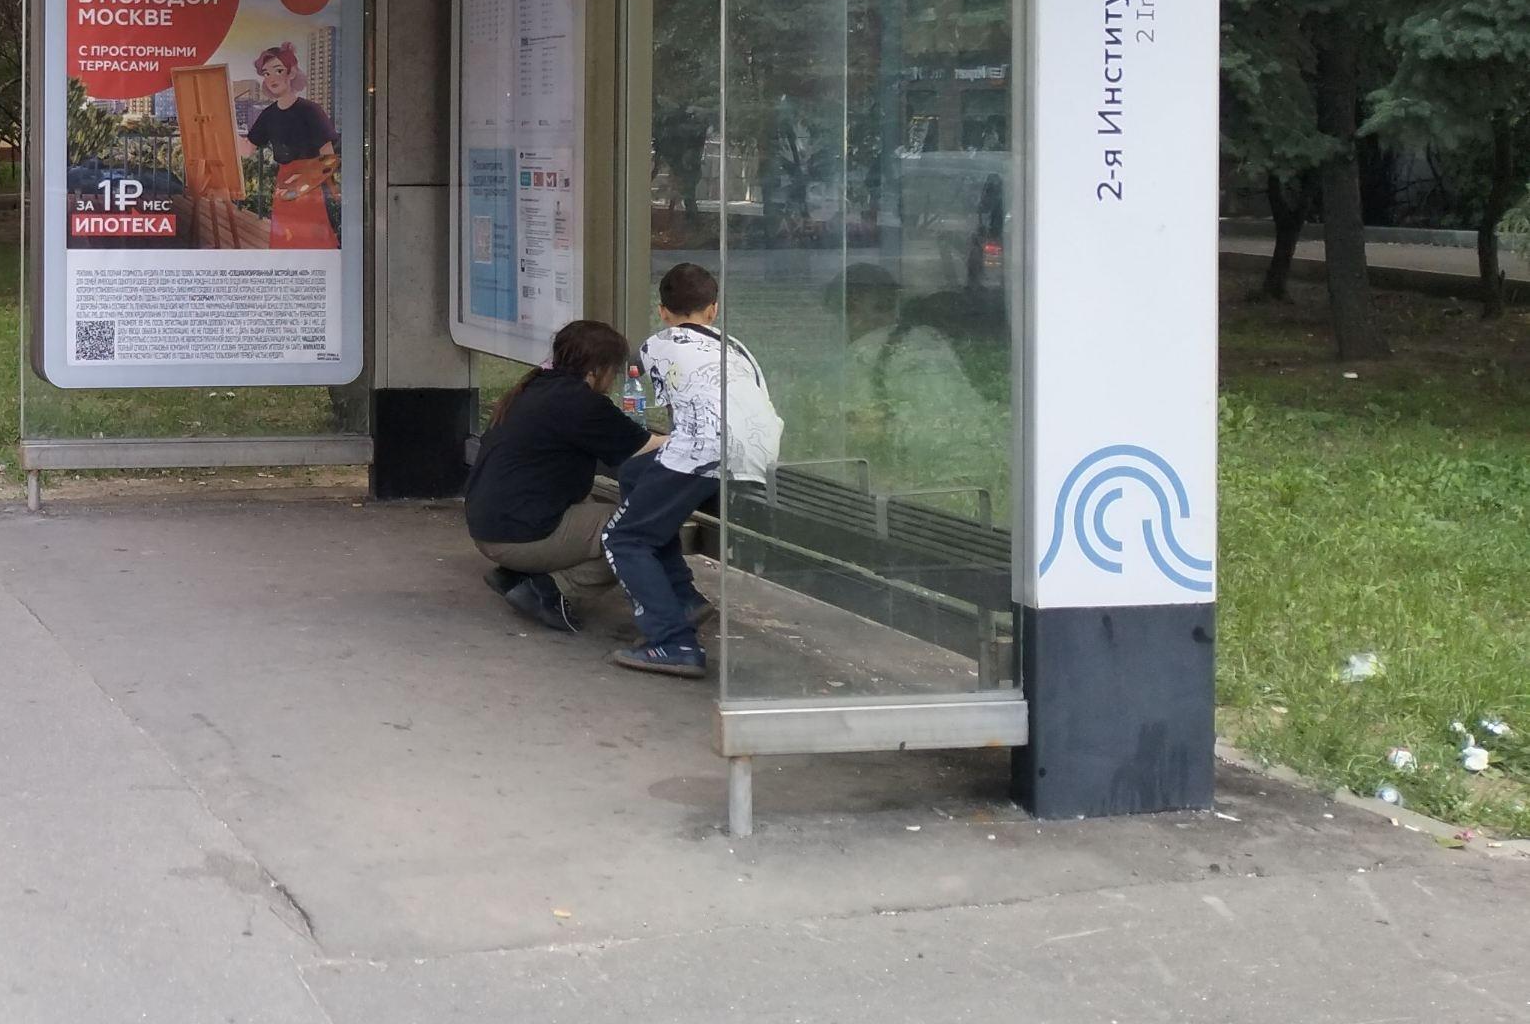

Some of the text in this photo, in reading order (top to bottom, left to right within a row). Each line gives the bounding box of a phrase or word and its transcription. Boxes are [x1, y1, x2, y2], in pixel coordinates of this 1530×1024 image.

[78, 8, 173, 26] МОСКВЕ
[1136, 28, 1156, 43] 2
[78, 45, 197, 57] С ПРОСТОРНЫМИ
[78, 60, 159, 72] ТЕРРАСАМИ
[1097, 148, 1124, 203] 2-я
[76, 200, 95, 211] ЗА
[75, 217, 173, 233] ИПОТЕКА
